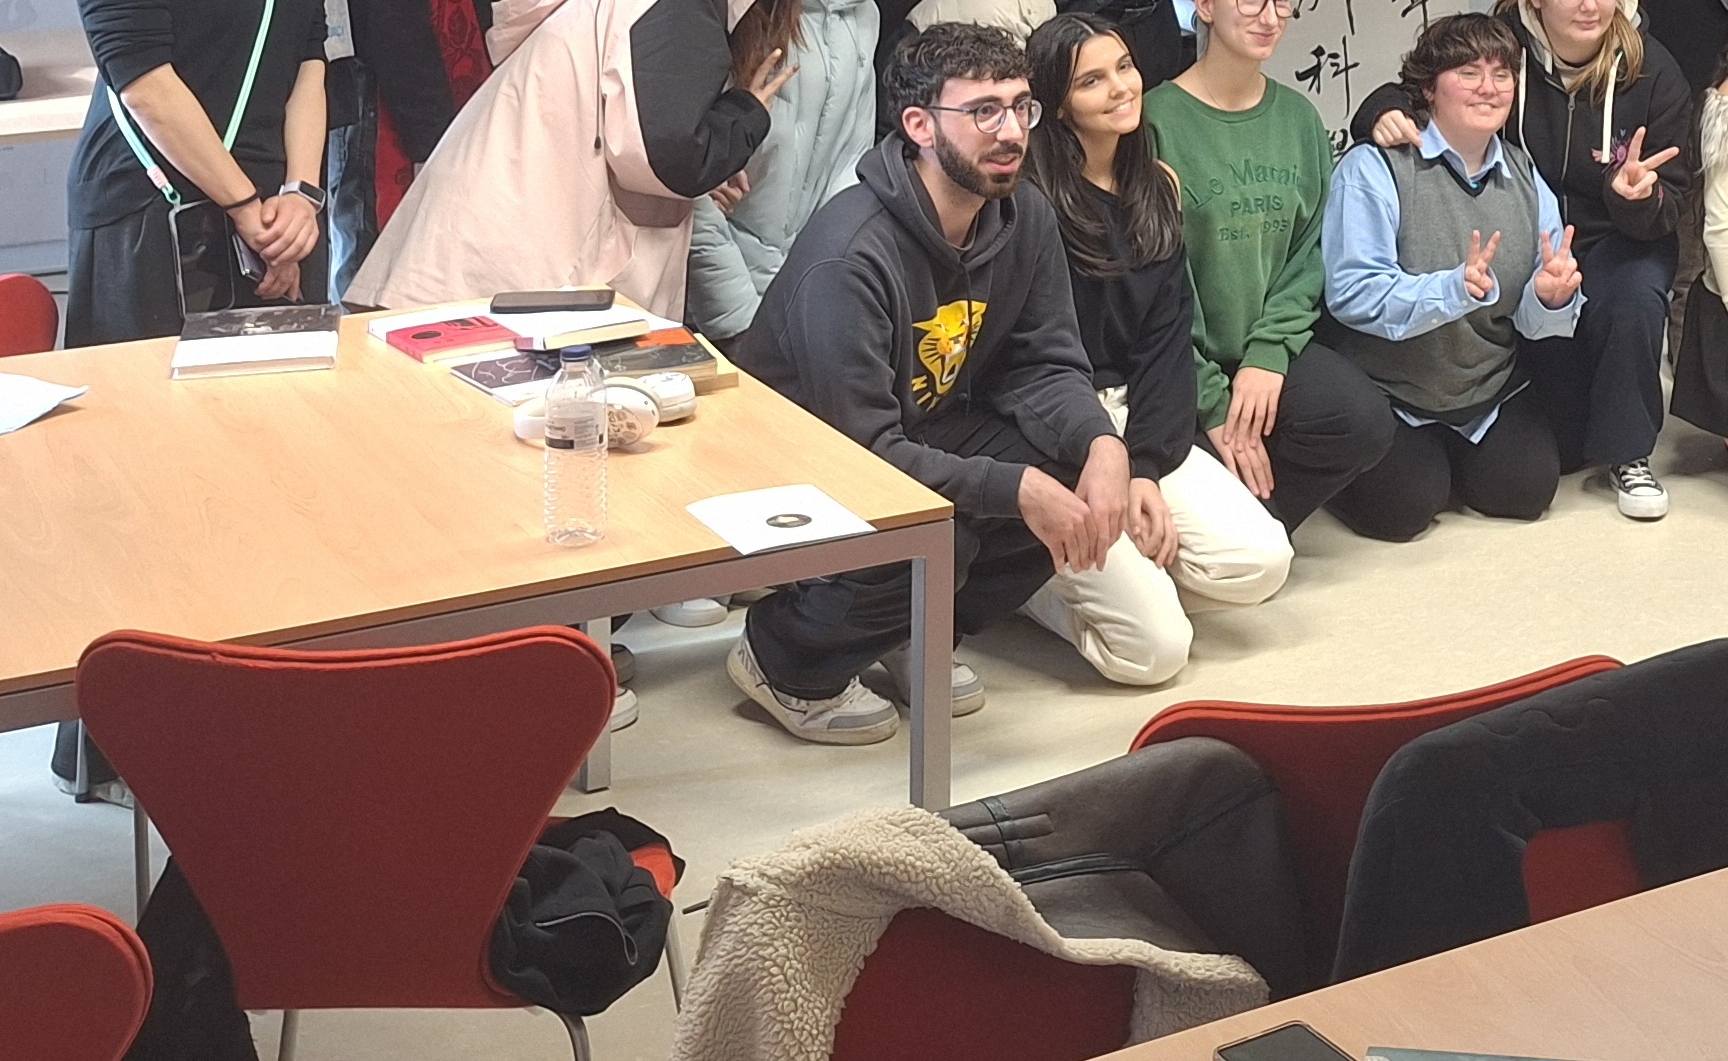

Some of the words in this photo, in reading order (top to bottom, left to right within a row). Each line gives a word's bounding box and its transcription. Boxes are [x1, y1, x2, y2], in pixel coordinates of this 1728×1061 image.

[1184, 177, 1224, 210] Le
[1231, 195, 1283, 217] PARIS
[1219, 227, 1250, 241] Est.
